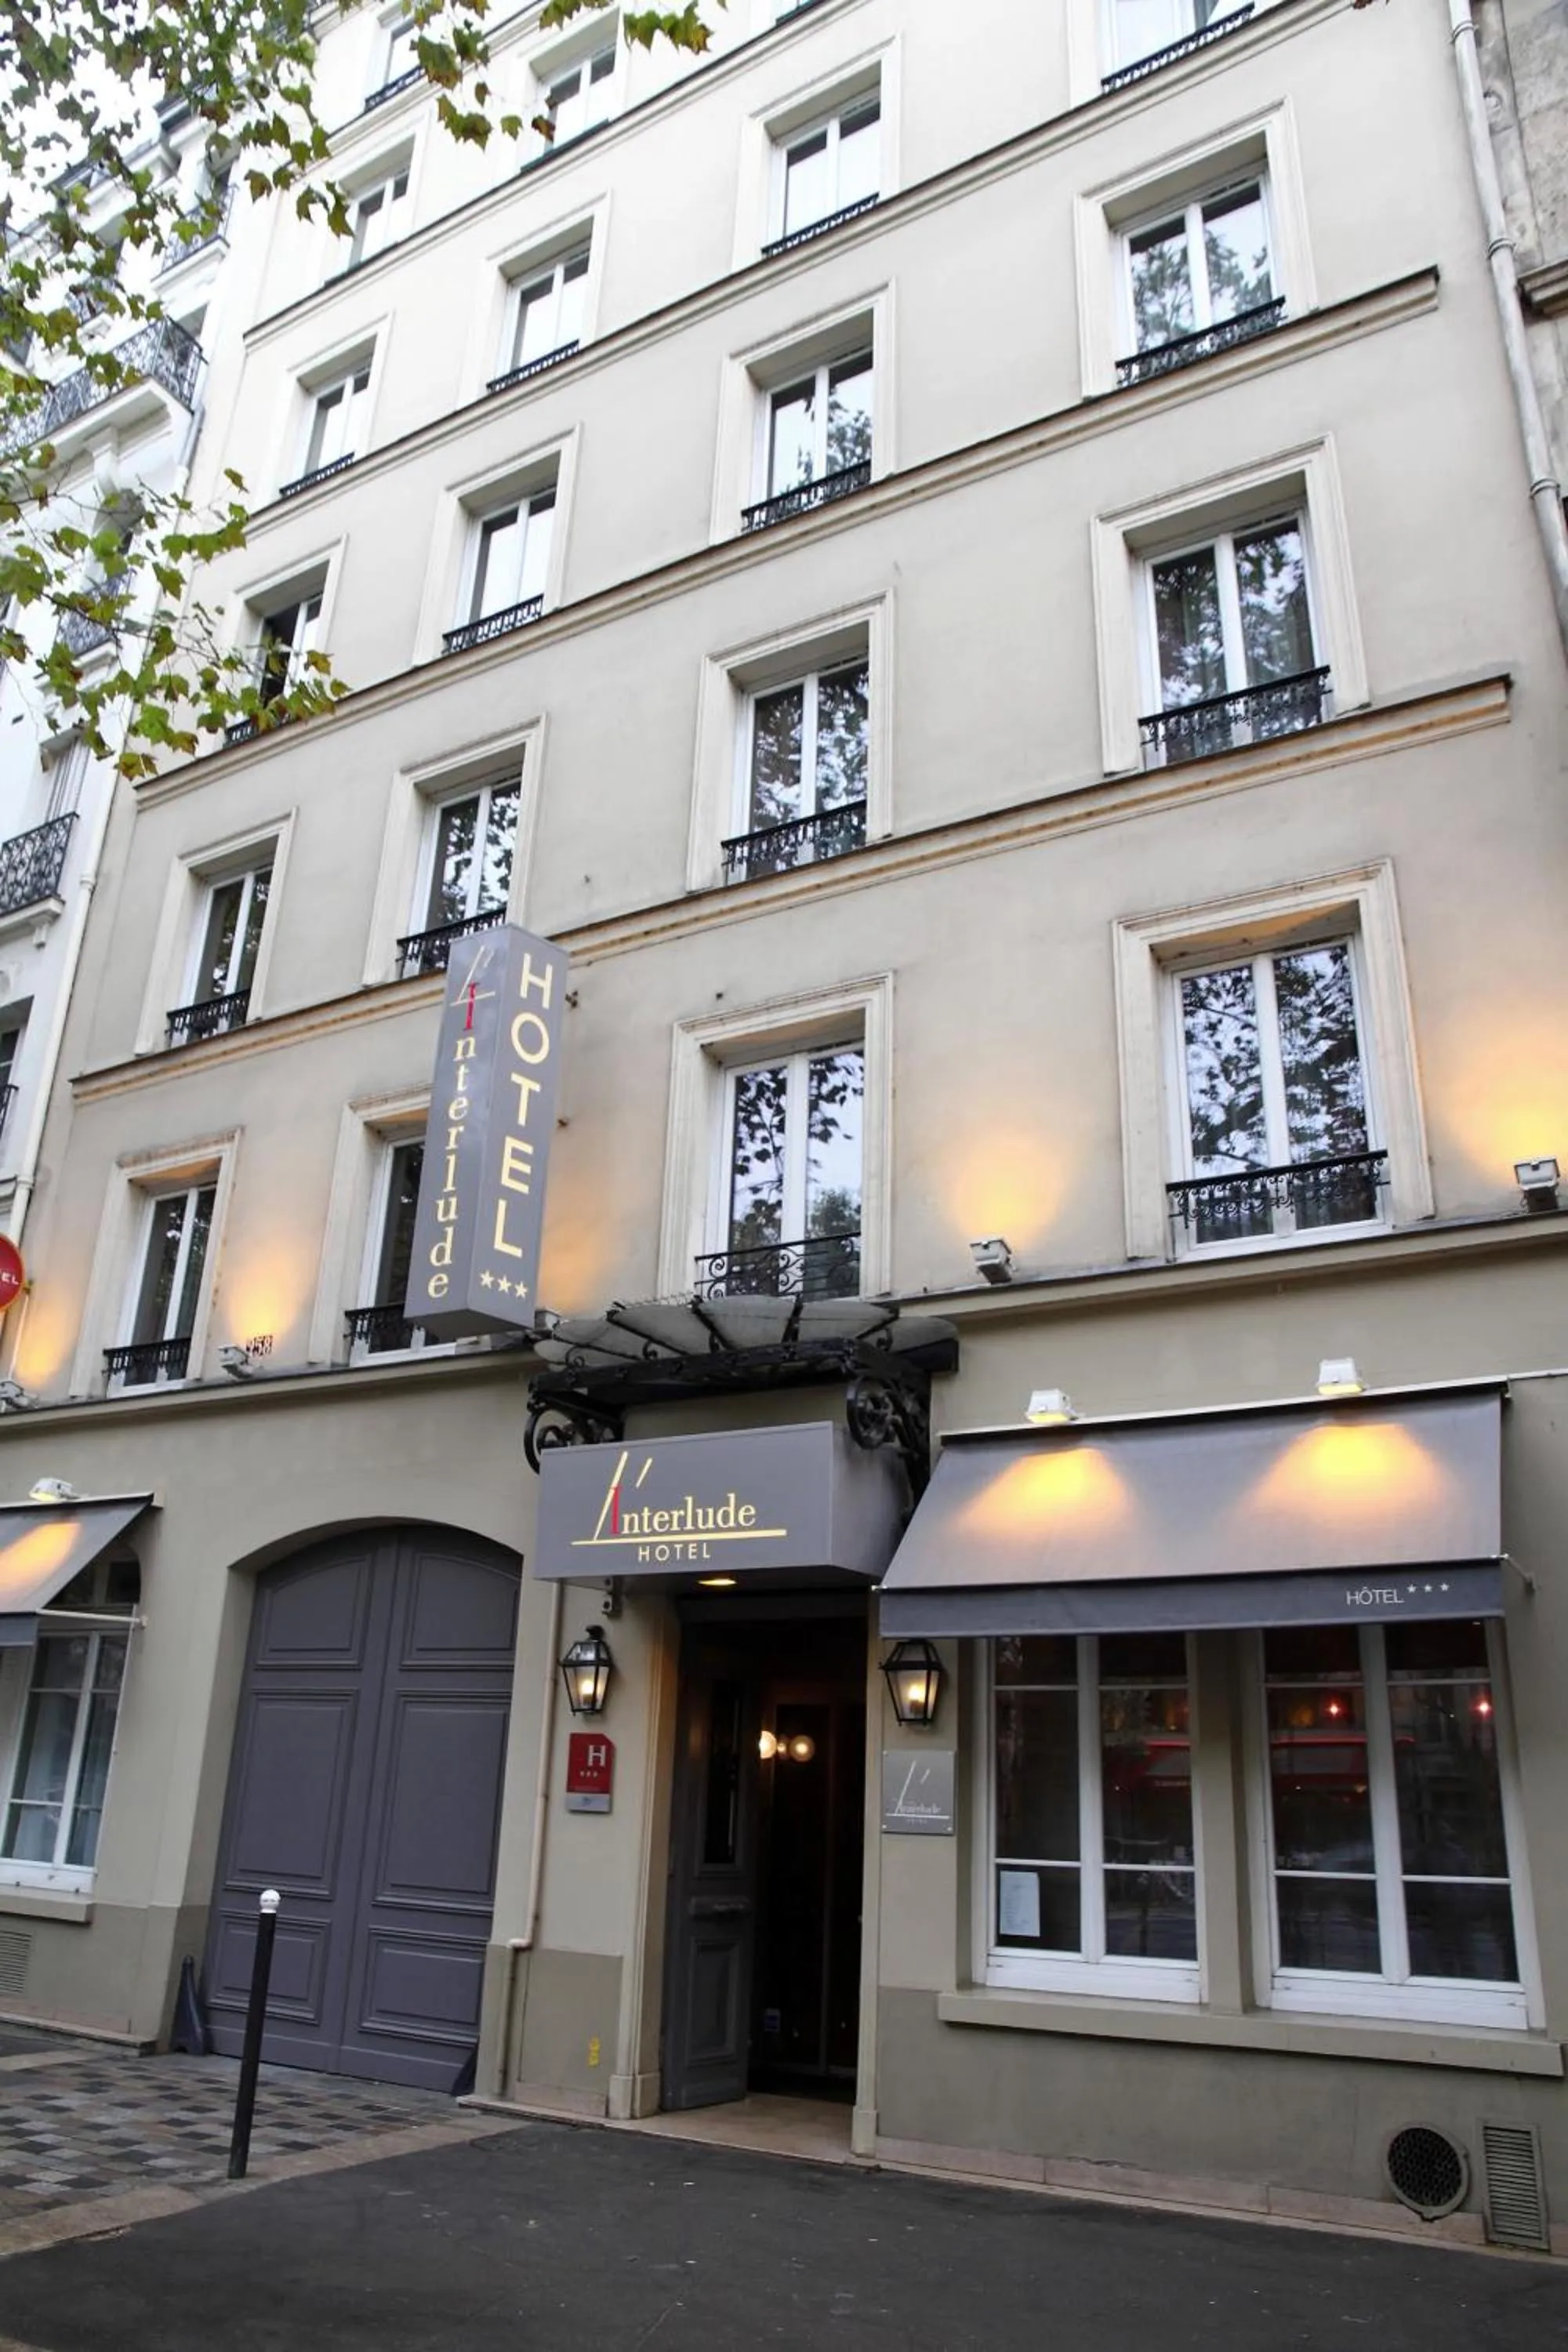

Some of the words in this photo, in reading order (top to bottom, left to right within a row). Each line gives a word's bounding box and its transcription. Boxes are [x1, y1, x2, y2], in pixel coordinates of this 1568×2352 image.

[493, 953, 554, 1258] HOTEL
[637, 1543, 710, 1563] HOTEL
[1346, 1586, 1405, 1606] HÔTEL
[588, 1744, 606, 1766] H
